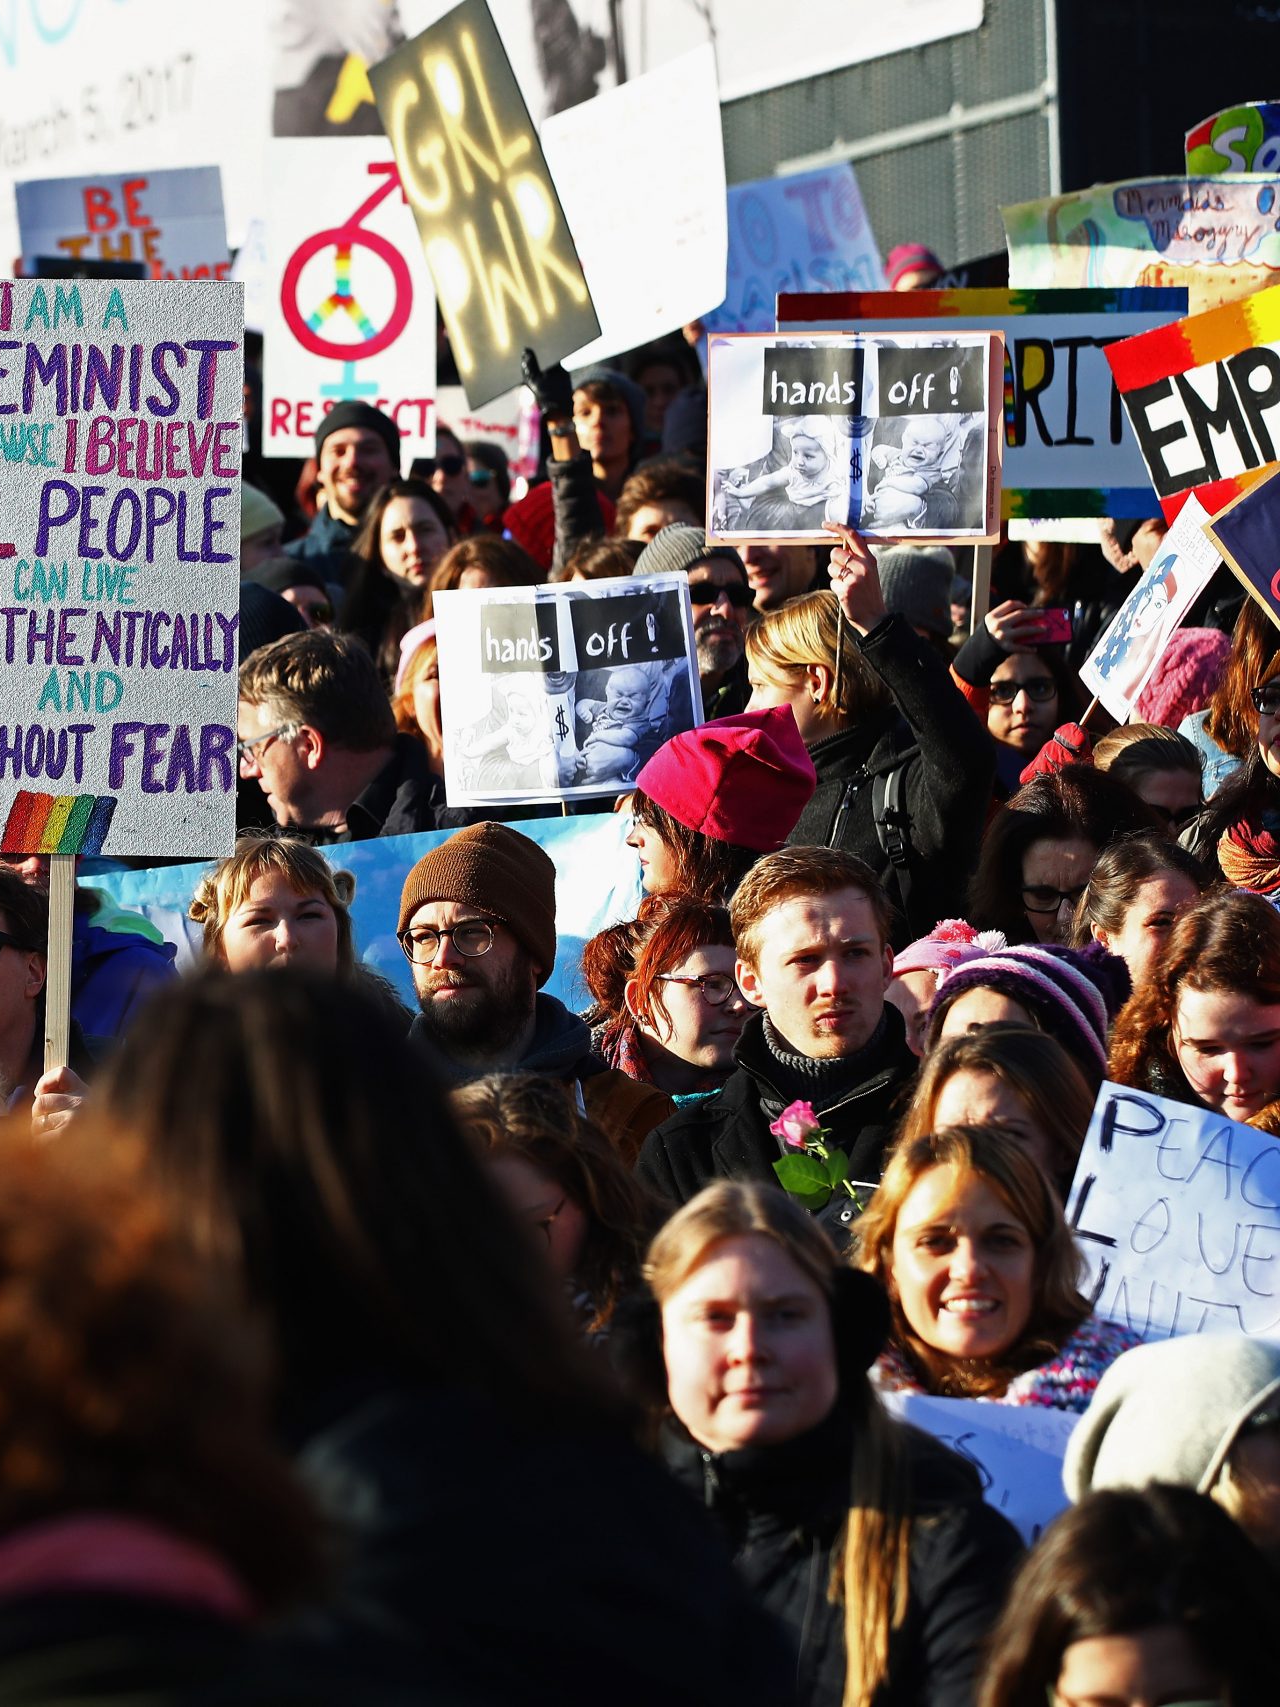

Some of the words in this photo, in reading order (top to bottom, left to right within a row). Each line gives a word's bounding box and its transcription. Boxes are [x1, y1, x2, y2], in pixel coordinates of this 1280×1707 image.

[120, 49, 198, 130] 2017
[390, 28, 532, 215] GRL
[83, 178, 151, 233] BE
[422, 172, 588, 376] PWR
[23, 285, 84, 330] AM
[102, 287, 128, 330] A
[271, 398, 435, 438] RECT
[770, 370, 856, 406] hands
[887, 373, 936, 409] off
[63, 419, 78, 473] I
[84, 415, 239, 481] BELIEVE
[1120, 346, 1280, 499] EMP
[34, 479, 234, 563] PEOPLE
[13, 558, 68, 603] CAN
[81, 559, 140, 604] LIVE
[485, 626, 553, 663] hands
[586, 621, 634, 660] off
[36, 667, 124, 714] AND
[108, 720, 237, 794] FEAR
